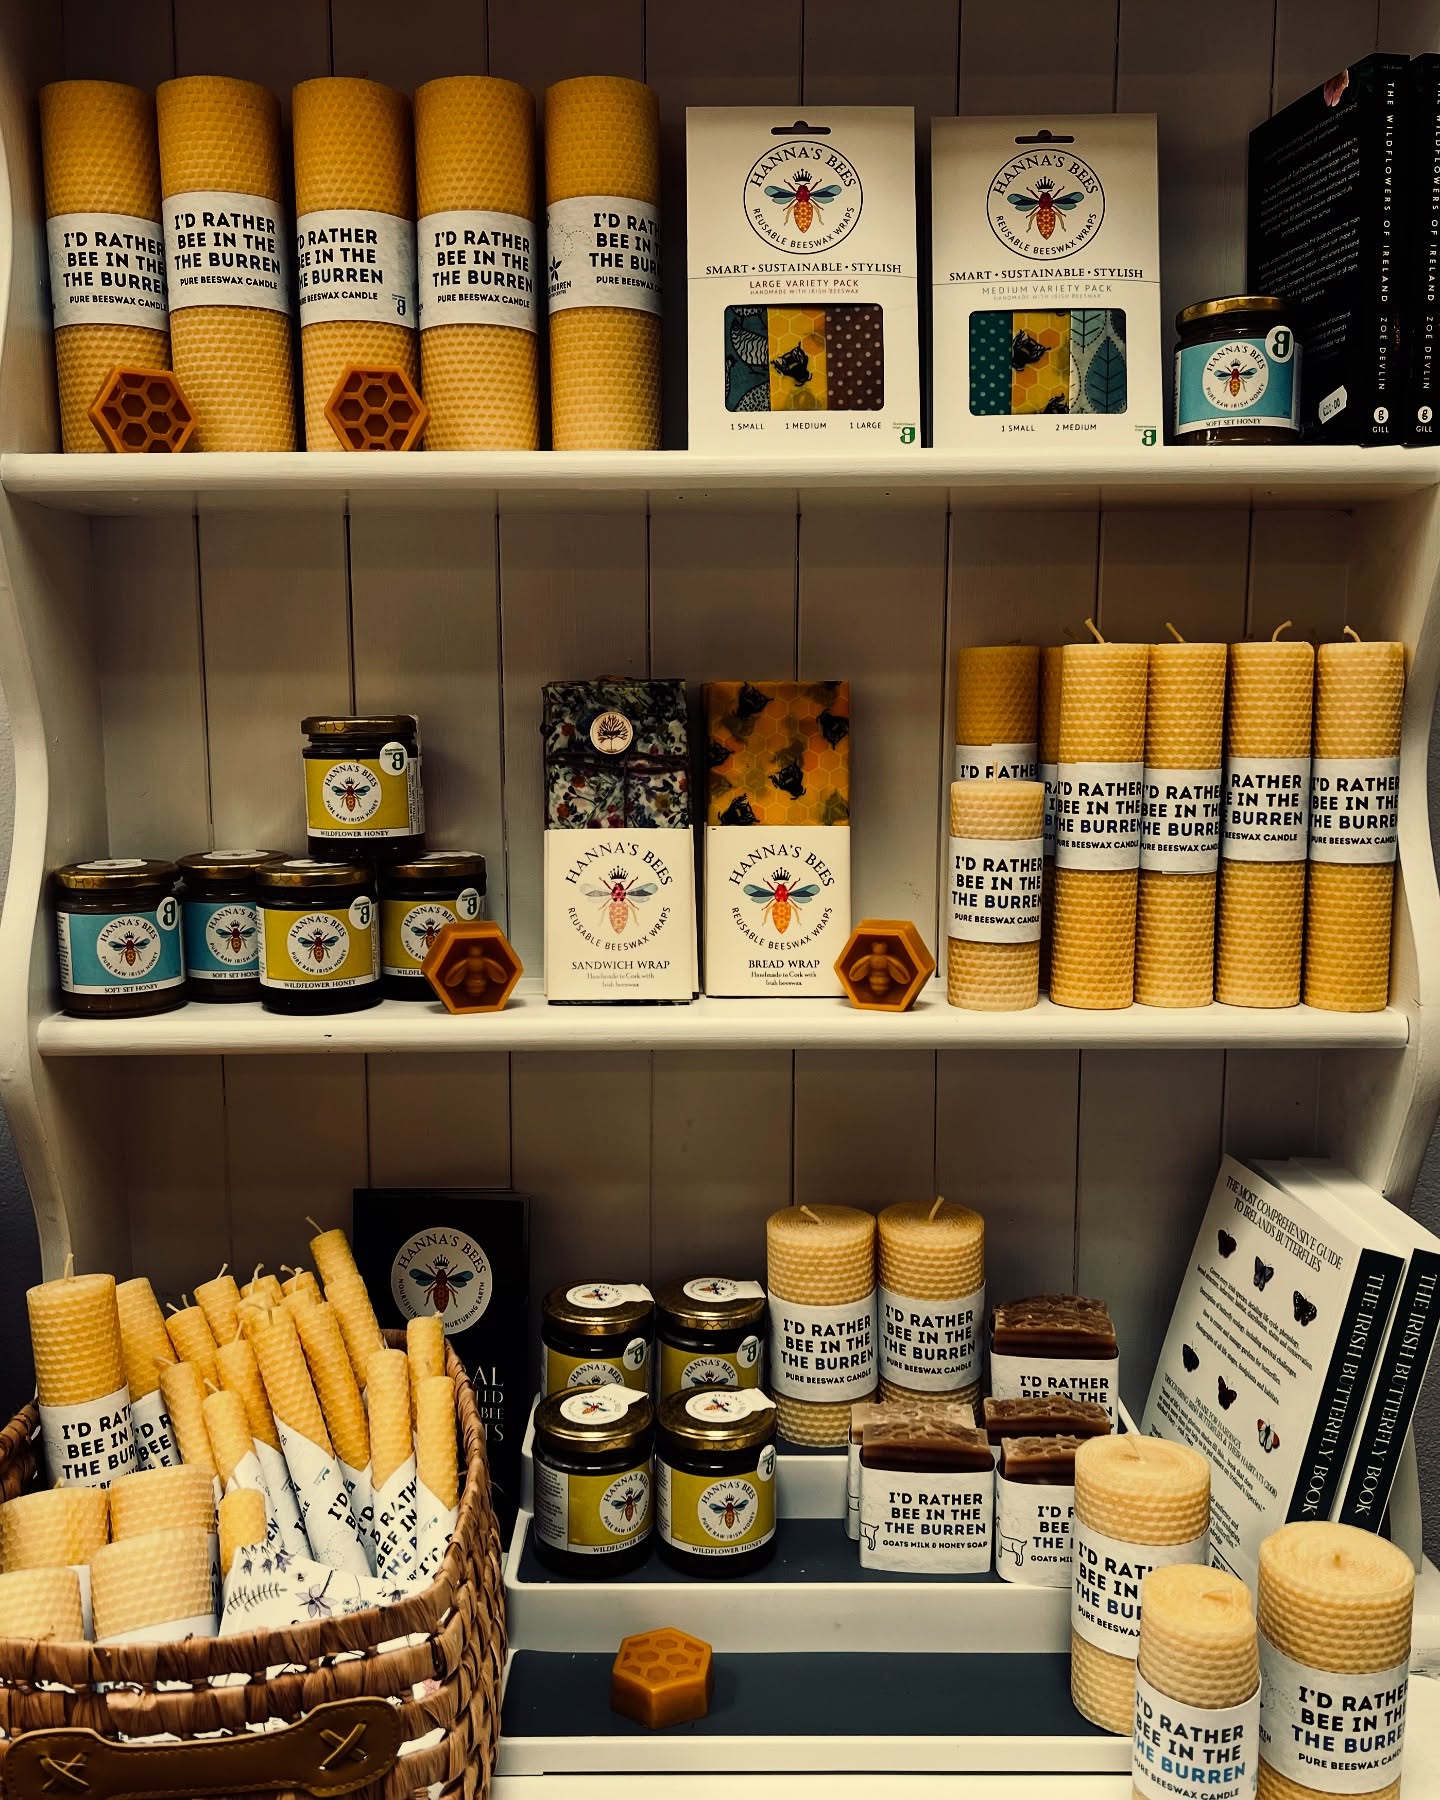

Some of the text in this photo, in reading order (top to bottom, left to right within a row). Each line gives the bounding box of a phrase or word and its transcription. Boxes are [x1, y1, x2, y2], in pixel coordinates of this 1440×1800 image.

[750, 146, 857, 188] HANNA'S BEES
[1383, 115, 1394, 212] WILDFLOWERS
[993, 155, 1099, 196] HANNA'S BEES
[174, 212, 275, 234] I'D RATHER
[752, 207, 855, 248] REUSABLE BEESWAX WRAPS
[1383, 220, 1390, 236] OF
[177, 232, 275, 253] BEE IN THE
[308, 228, 378, 245] RATHER
[435, 230, 530, 252] I'D RATHER
[174, 252, 280, 274] THE BURREN
[315, 248, 376, 264] IN THE
[437, 250, 529, 272] BEE IN THE
[312, 268, 383, 284] BURREN
[706, 263, 901, 275] SMART SUSTAINABLE STYLISH
[950, 269, 1143, 281] SMART SUSTAINABLE STYLISH
[1381, 246, 1390, 302] IRELAND
[180, 276, 277, 289] PURE BEESWAX CANDLE
[433, 270, 532, 293] THE BURREN
[750, 279, 859, 289] LARGE VARIETY PACK
[982, 286, 1028, 294] MEDIUM
[1033, 285, 1080, 293] VARIETY
[1207, 345, 1266, 372] HANNA'S BEES
[325, 765, 378, 787] HANNA'S BEES
[1232, 774, 1301, 789] RATHER
[1237, 793, 1299, 807] IN THE
[1232, 811, 1302, 826] BURREN
[565, 842, 673, 886] HANNA'S BEES
[729, 844, 835, 887] HANNA'S BEES
[956, 856, 1042, 872] I'D RATHER
[957, 874, 1041, 890] BEE IN THE
[952, 891, 977, 908] THE
[290, 915, 346, 938] HANNA'S BEES
[568, 907, 671, 951] REUSABLE BEESWAX WRAPS
[732, 907, 832, 950] REUSABLE BEESWAX WRAPS
[955, 913, 1039, 924] PURE BEESWAX CANDLE
[572, 961, 670, 969] SANDWICH WRAP
[749, 960, 820, 968] BREAD WRAP
[332, 979, 356, 987] HONEY
[1226, 1176, 1343, 1270] THE MOST COMPREHENSIVE GUIDE
[1234, 1198, 1243, 1212] TO
[1275, 1229, 1322, 1272] BUTTERFLIES
[397, 1233, 487, 1274] HANNA'S BEES
[444, 1281, 485, 1330] NURTURING EARTH
[784, 1315, 871, 1337] I'D RATHER
[785, 1331, 870, 1353] BEE IN THE
[781, 1349, 873, 1370] THE BURREN
[785, 1368, 871, 1384] PURE BEESWAX CANDLE
[1301, 1274, 1385, 1516] THE IRISH BUTTERFLY BOOK
[1355, 1274, 1437, 1516] THE IRISH BUTTERFLY BOOK
[62, 1422, 91, 1439] I'D
[67, 1429, 128, 1459] BEE IN
[63, 1460, 100, 1479] THE
[701, 1481, 756, 1504] HANNA'S BEES
[889, 1492, 983, 1505] I'D RATHER
[891, 1507, 981, 1520] BEE IN THE
[885, 1522, 986, 1535] THE BURREN
[692, 1539, 762, 1555] WILDFLOWER HONEY
[1299, 1685, 1332, 1709] I'D
[1160, 1713, 1244, 1744] RATHER
[1301, 1708, 1377, 1732] BEE IN
[1136, 1713, 1241, 1763] BEE IN THE
[1292, 1724, 1335, 1752] THE
[1161, 1757, 1245, 1784] BURREN
[1298, 1752, 1379, 1770] PURE BEESWAX
